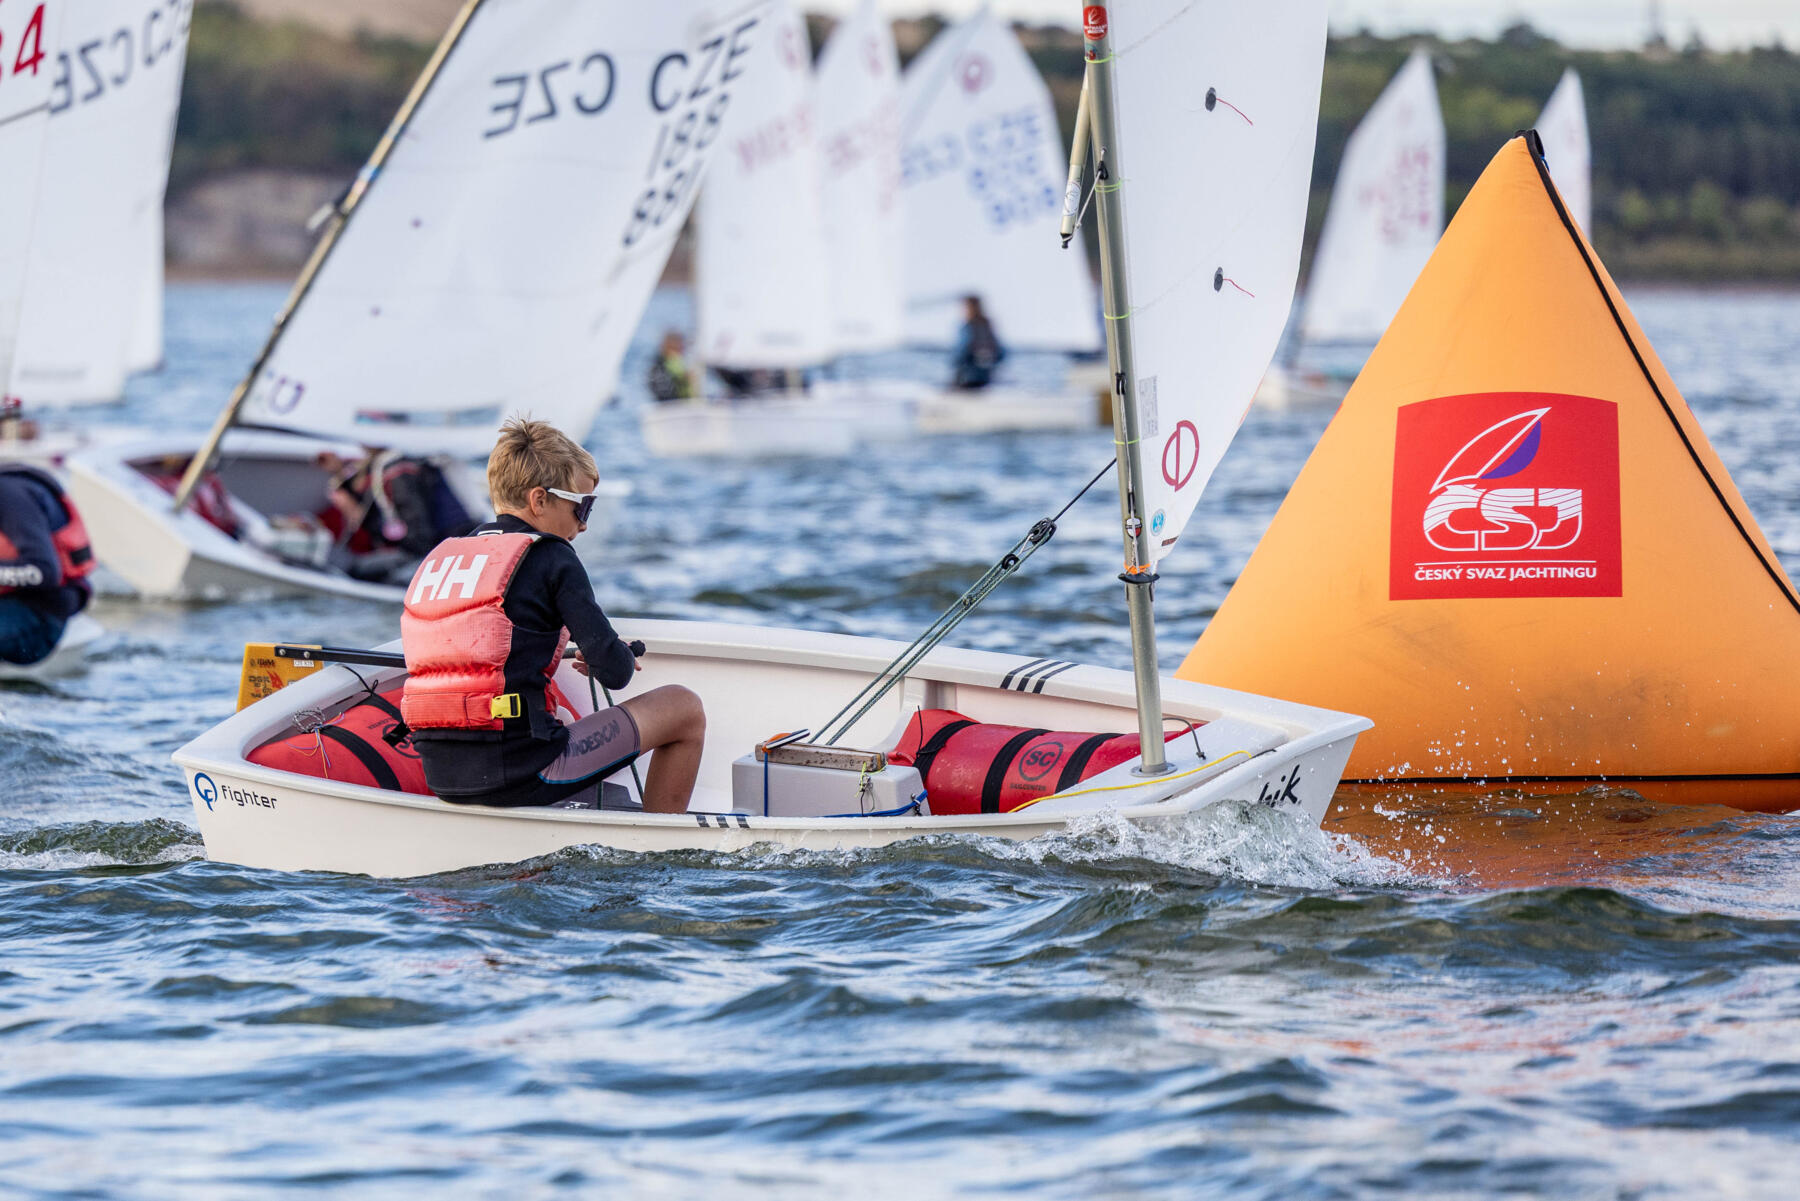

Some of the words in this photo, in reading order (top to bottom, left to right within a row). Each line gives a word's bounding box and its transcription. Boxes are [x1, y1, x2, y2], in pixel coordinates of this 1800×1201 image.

[0, 3, 46, 80] 4
[649, 18, 759, 113] CZE
[410, 554, 489, 606] HH
[1414, 565, 1463, 581] ČESKÝ
[1466, 567, 1506, 580] SVAZ
[1509, 566, 1597, 581] JACHTINGU
[1026, 750, 1056, 767] SC
[221, 785, 277, 809] fighter
